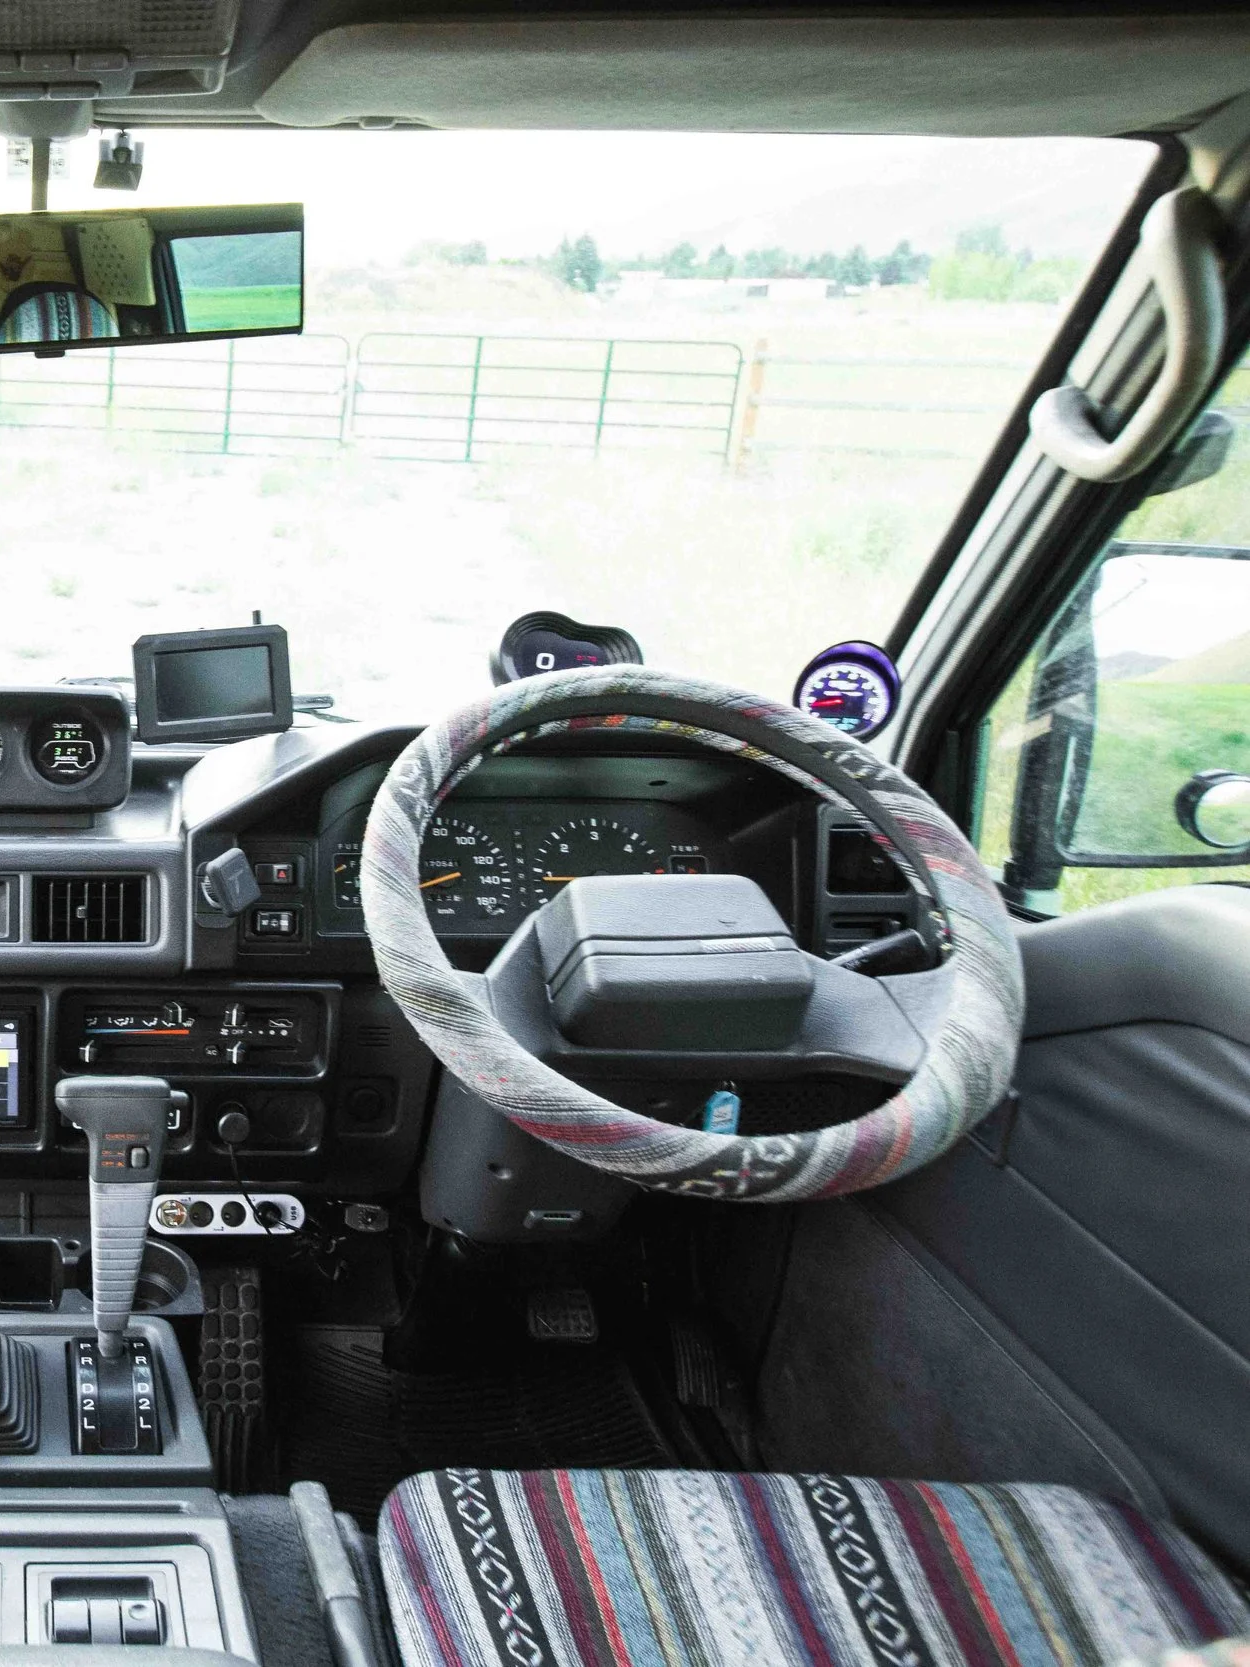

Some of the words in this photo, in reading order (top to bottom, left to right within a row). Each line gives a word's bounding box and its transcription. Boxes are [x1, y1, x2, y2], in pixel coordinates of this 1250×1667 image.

[535, 652, 555, 670] 0
[455, 836, 476, 845] 100
[589, 831, 599, 841] 3
[559, 843, 570, 853] 2
[623, 844, 634, 853] 4
[472, 856, 494, 864] 120
[479, 876, 501, 884] 140
[476, 897, 498, 905] 160
[81, 1356, 93, 1365] R
[135, 1356, 147, 1364] R
[82, 1383, 94, 1393] D
[137, 1382, 149, 1393] D
[83, 1399, 95, 1410] 2
[138, 1398, 151, 1409] 2
[83, 1417, 96, 1429] L
[139, 1416, 152, 1428] L
